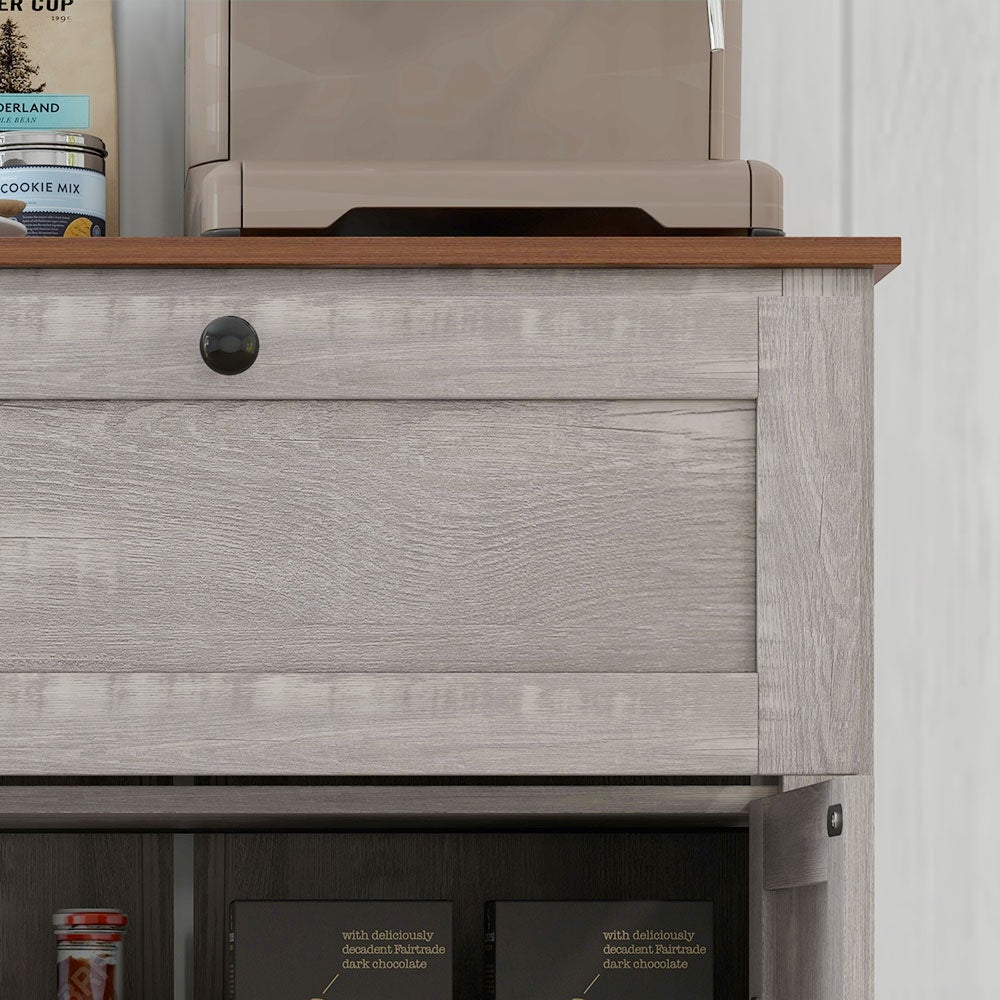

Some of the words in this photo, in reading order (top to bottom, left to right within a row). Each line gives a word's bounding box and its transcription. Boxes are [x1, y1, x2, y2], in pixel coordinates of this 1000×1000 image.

[31, 0, 74, 11] CUP
[0, 182, 53, 194] COOKIE
[57, 183, 80, 194] MIX
[342, 930, 369, 941] with
[372, 930, 435, 942] deliciously
[603, 930, 630, 941] with
[633, 930, 696, 942] deliciously
[342, 944, 393, 955] decadent
[394, 944, 446, 955] Fairtrade
[603, 944, 654, 955] decadent
[655, 944, 707, 955] Fairtrade
[342, 958, 370, 969] dark
[372, 958, 427, 969] chocolate
[603, 958, 631, 969] dark
[633, 958, 688, 969] chocolate
